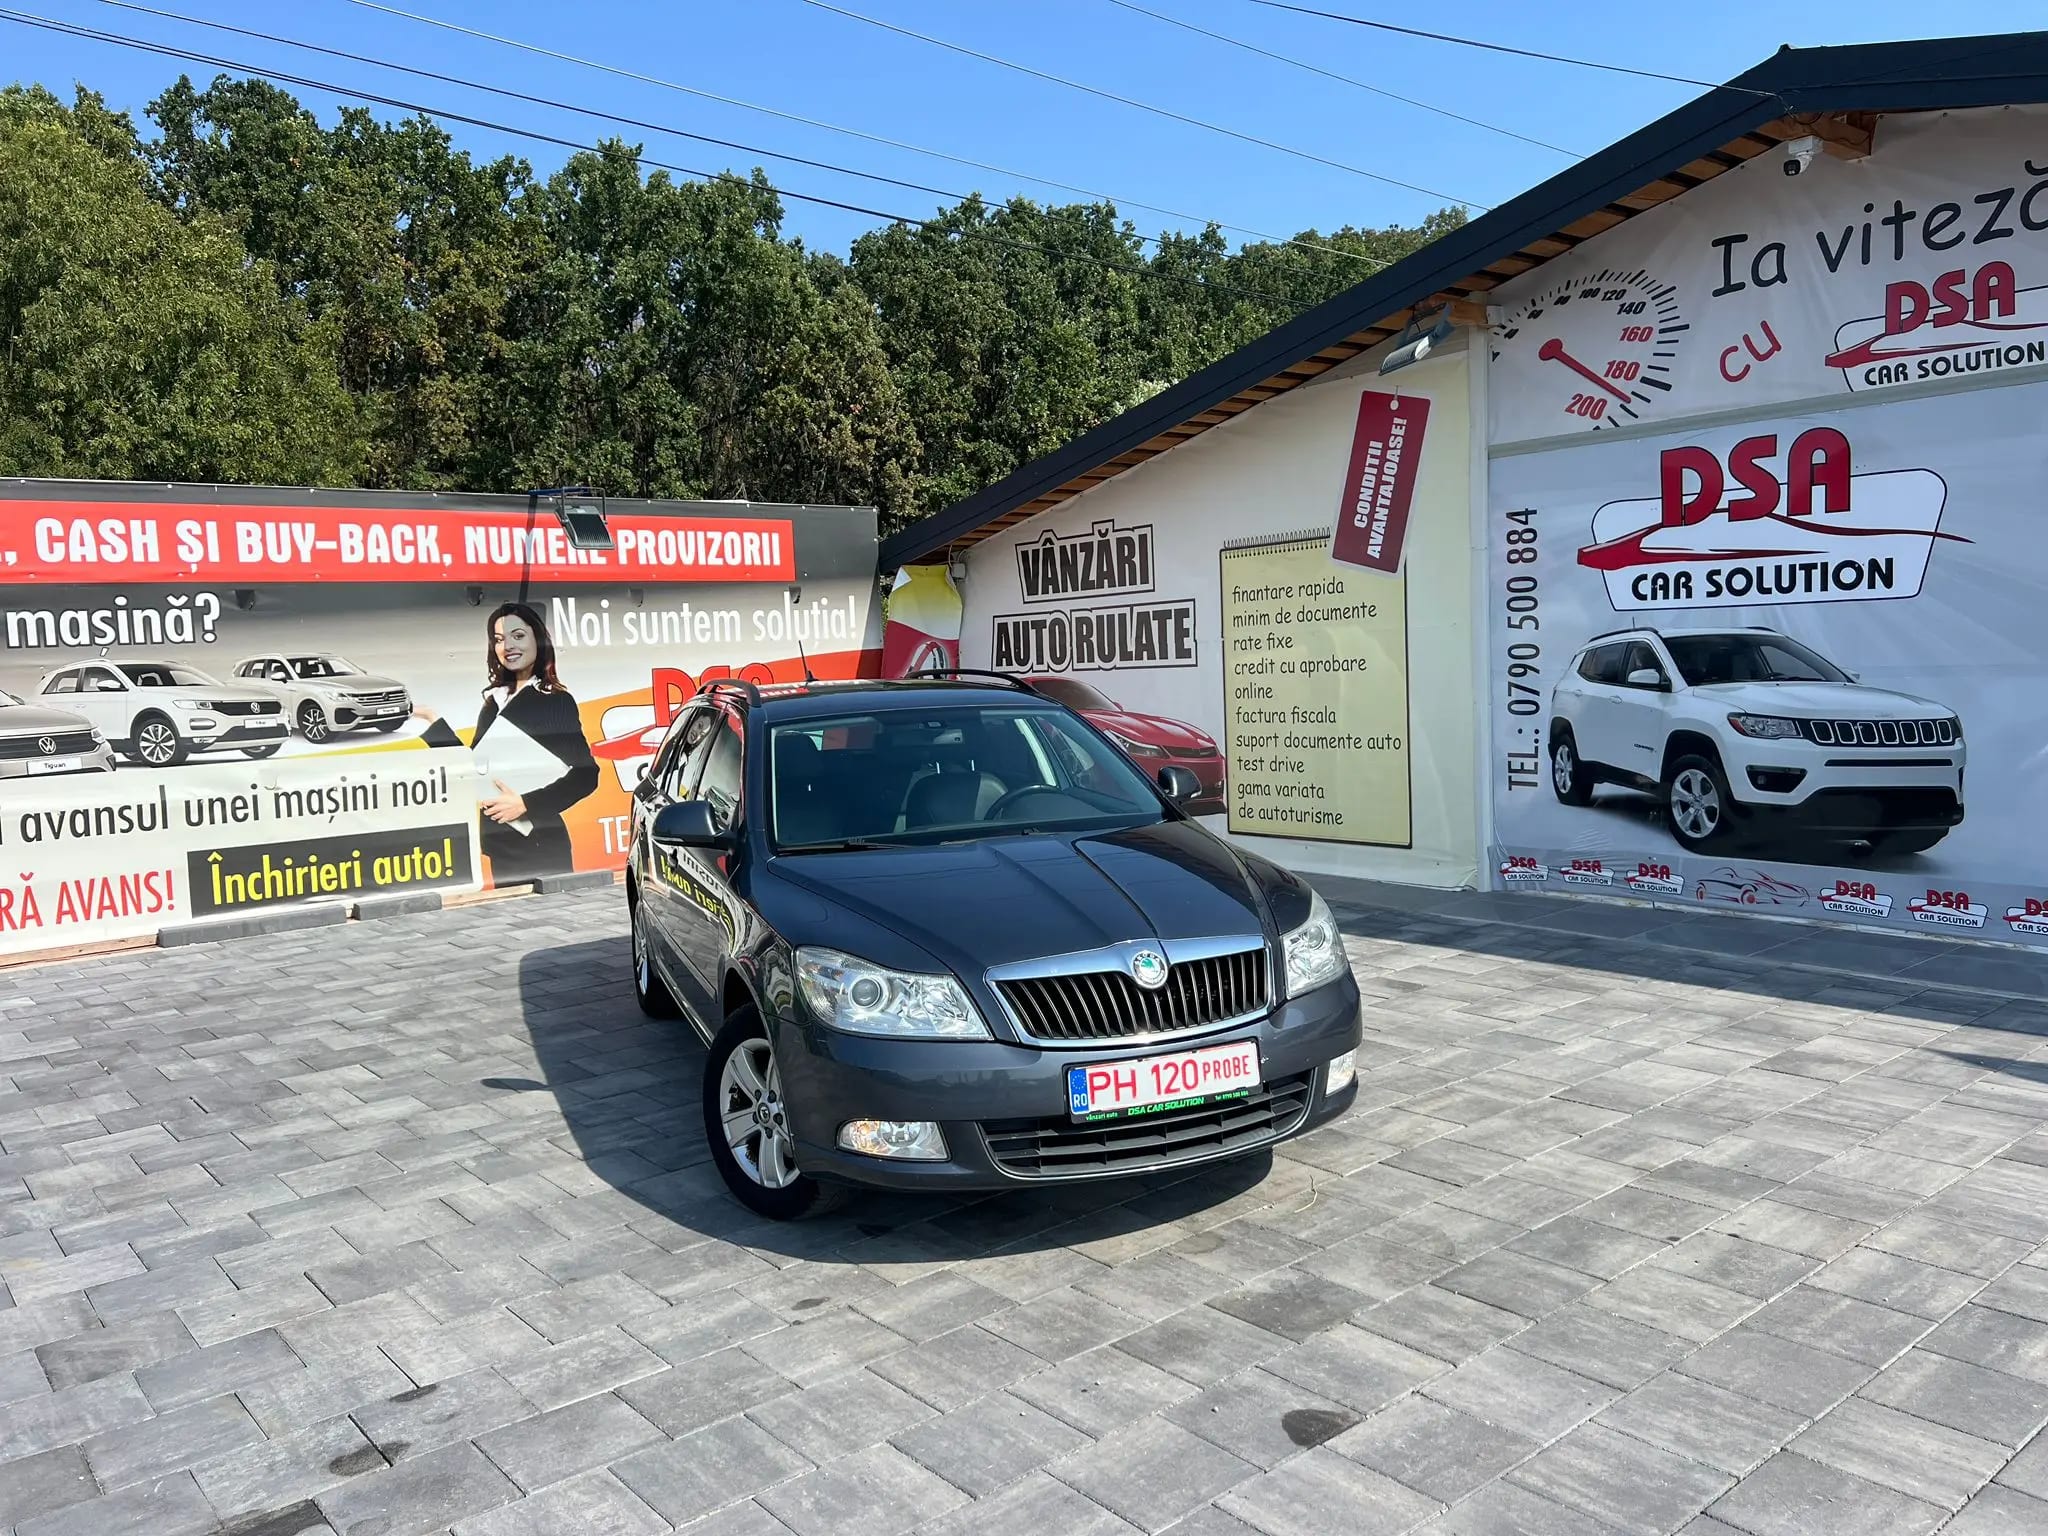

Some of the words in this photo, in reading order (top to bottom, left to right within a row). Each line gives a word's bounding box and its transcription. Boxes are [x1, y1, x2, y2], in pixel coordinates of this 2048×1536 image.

[1711, 233, 1787, 298] Ia
[1579, 288, 1601, 299] 100
[1601, 288, 1627, 301] 120
[1885, 260, 2016, 336] DSA
[1616, 301, 1646, 315] 140
[1619, 326, 1653, 342] 160
[1720, 320, 1783, 383] cu
[1604, 360, 1640, 381] 180
[1864, 360, 1910, 387] CAR
[1918, 341, 2045, 380] SOLUTION
[1565, 393, 1608, 420] 200
[1354, 440, 1383, 528] CONDITII
[1367, 417, 1407, 559] AVANTAJOASE!
[1660, 427, 1851, 527] DSA
[35, 518, 157, 563] CASH
[176, 522, 220, 573] ȘI
[236, 522, 452, 567] BUY-BACK,
[617, 529, 781, 567] PROVIZORII
[1506, 508, 1538, 564] 884
[1021, 528, 1150, 596] VÂNZĂRI
[1232, 585, 1294, 604] finantare
[1298, 576, 1344, 601] rapida
[1631, 570, 1693, 601] CAR
[1706, 557, 1894, 598] SOLUTION
[1233, 609, 1271, 627] minim
[1275, 606, 1292, 625] de
[1297, 602, 1377, 623] documente
[1506, 576, 1540, 630] 500
[6, 591, 221, 657] mașină?
[551, 597, 611, 647] Noi
[622, 602, 742, 645] suntem
[996, 617, 1068, 667] AUTO
[1075, 608, 1192, 663] RULATE
[1233, 636, 1262, 651] rate
[1266, 632, 1294, 650] fixe
[1234, 657, 1275, 675] credit
[1280, 661, 1295, 674] cu
[1300, 654, 1367, 678] aprobare
[1235, 682, 1273, 699] online
[1507, 643, 1540, 715] 0790
[1235, 706, 1286, 724] factura
[1291, 705, 1337, 724] fiscala
[1236, 733, 1279, 752] suport
[1284, 731, 1362, 750] documente
[1367, 733, 1401, 750] auto
[1237, 756, 1265, 771] test
[1269, 755, 1305, 773] drive
[1238, 782, 1271, 799] gama
[1275, 781, 1325, 799] variata
[20, 785, 169, 843] avansul
[184, 783, 260, 827] unei
[274, 774, 378, 823] mașini
[391, 766, 449, 805] noi!
[1238, 802, 1254, 819] de
[1258, 805, 1344, 825] autoturisme
[598, 815, 630, 854] TE
[207, 850, 363, 906] Închirieri
[372, 838, 454, 887] auto!
[1509, 856, 1537, 868] DSA
[1638, 862, 1671, 879] DSA
[1518, 873, 1545, 881] SOLUTION
[1580, 876, 1609, 885] SOLUTION
[1634, 882, 1646, 890] CAR
[1648, 883, 1678, 893] SOLUTION
[56, 870, 175, 925] AVANS!
[1835, 880, 1875, 900] DSA
[1926, 889, 1969, 910] DSA
[1828, 902, 1843, 910] CAR
[1844, 904, 1884, 916] SOLUTION
[1919, 912, 1934, 921] CAR
[1937, 913, 1978, 926] SOLUTION
[2025, 898, 2048, 916] DS
[2017, 923, 2032, 931] CAR
[1073, 1093, 1087, 1107] RO
[1088, 1069, 1137, 1104] PH
[1151, 1059, 1198, 1095] 120
[1203, 1055, 1250, 1083] PROBE
[1128, 1106, 1146, 1116] DSA
[1147, 1103, 1165, 1113] CAR
[1165, 1097, 1205, 1109] SOLUTION
